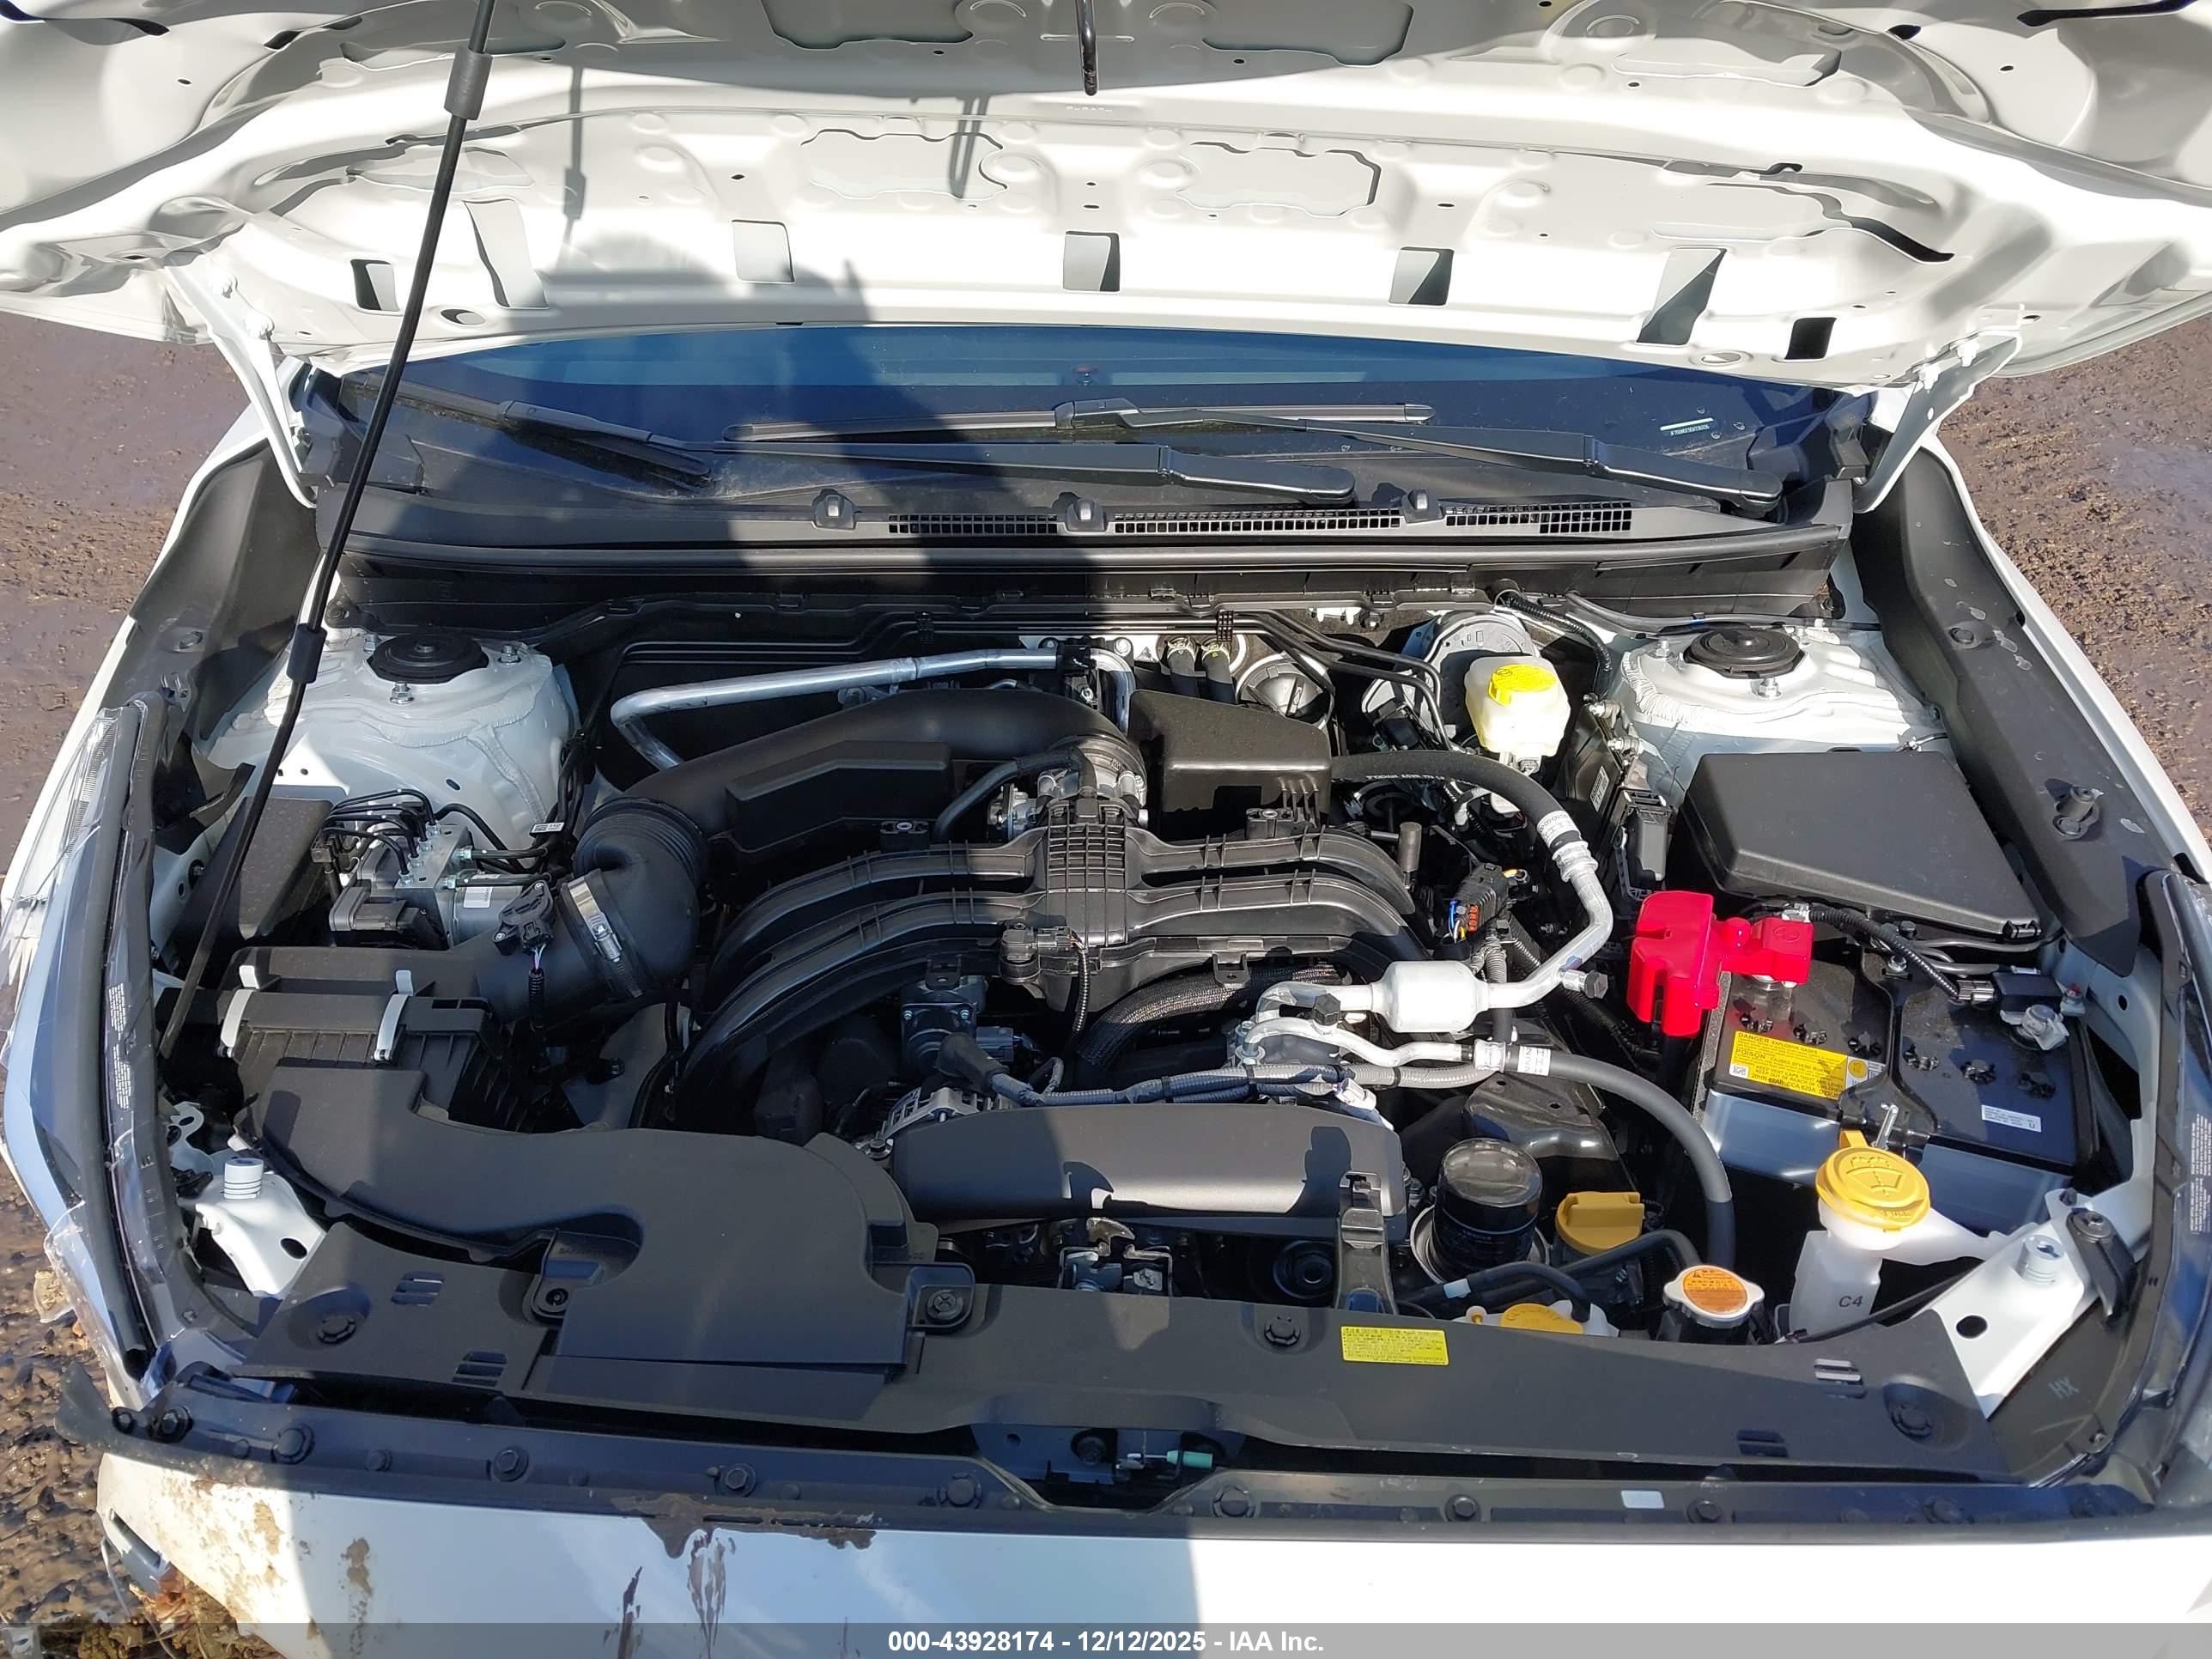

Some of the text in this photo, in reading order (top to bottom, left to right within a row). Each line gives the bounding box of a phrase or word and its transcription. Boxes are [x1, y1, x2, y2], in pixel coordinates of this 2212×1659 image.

[1738, 1032, 1769, 1042] DANGER
[1735, 1048, 1766, 1059] POISON
[1838, 1295, 1863, 1308] C4
